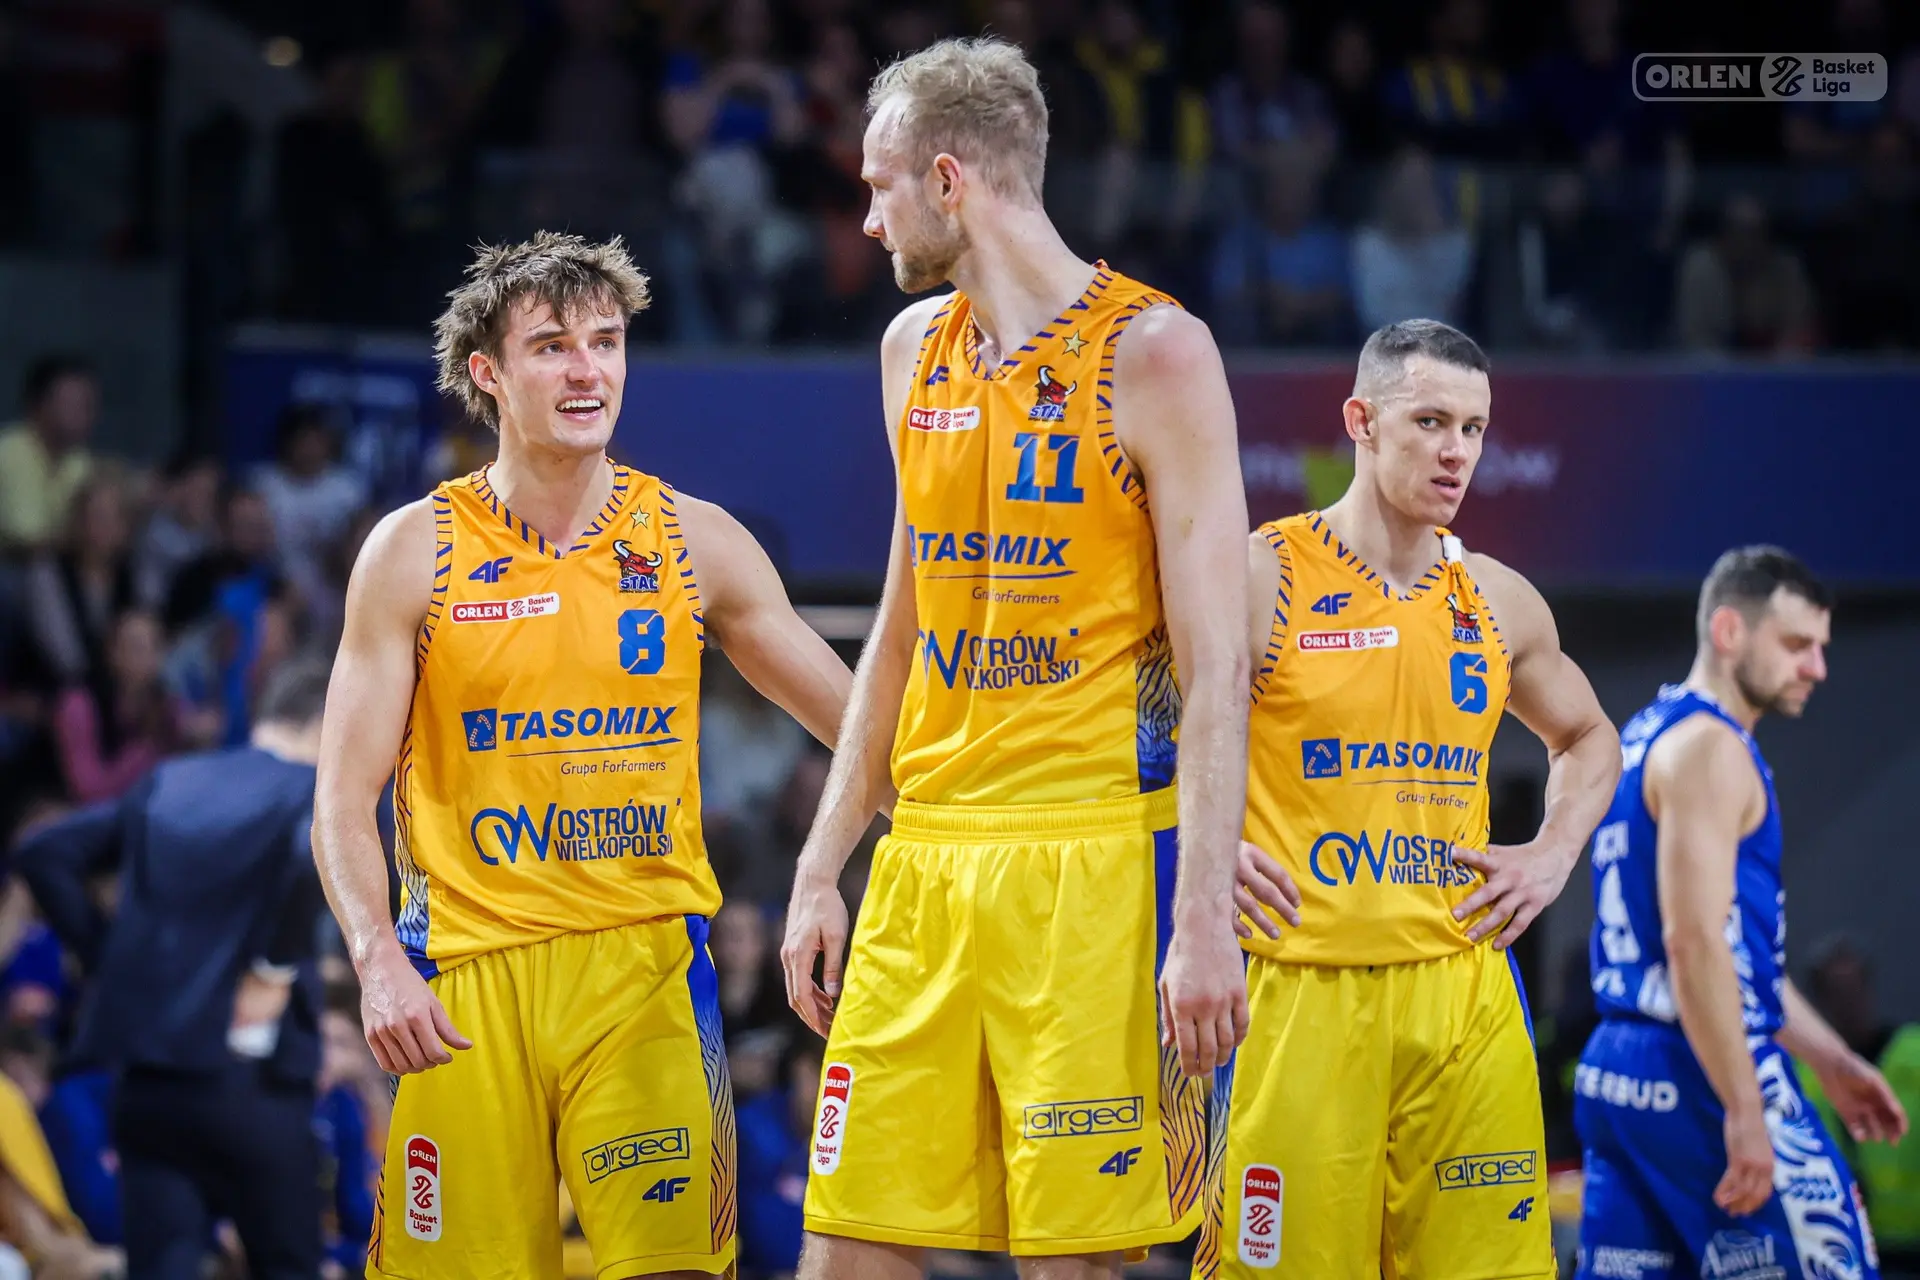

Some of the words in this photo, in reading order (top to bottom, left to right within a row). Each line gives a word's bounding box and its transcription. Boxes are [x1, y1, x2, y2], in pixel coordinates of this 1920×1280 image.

[1006, 432, 1085, 503] 11
[468, 556, 513, 584] 4F
[620, 575, 659, 590] STAL
[456, 605, 503, 619] ORLEN
[528, 596, 554, 606] Basket
[528, 605, 544, 615] Liga
[1311, 592, 1352, 615] 4F
[618, 609, 666, 675] 8
[1303, 635, 1346, 648] ORLEN
[1449, 652, 1488, 714] 6
[501, 706, 677, 741] TASOMIX
[560, 761, 598, 777] Grupa
[602, 759, 667, 774] ForFarmers
[1346, 742, 1484, 777] TASOMIX
[557, 798, 667, 840] OSTRÓW
[825, 1078, 848, 1089] ORLEN
[1030, 1098, 1138, 1135] arged
[410, 1149, 437, 1163] ORLEN
[590, 1128, 683, 1171] arged
[1098, 1146, 1143, 1176] 4F
[1445, 1152, 1533, 1186] arged
[642, 1177, 691, 1203] 4F
[1247, 1178, 1279, 1190] ORLEN
[409, 1209, 438, 1224] Basket
[1508, 1196, 1535, 1222] 4F
[413, 1221, 432, 1232] Liga
[1243, 1238, 1275, 1249] Basket
[1249, 1248, 1269, 1259] Liga
